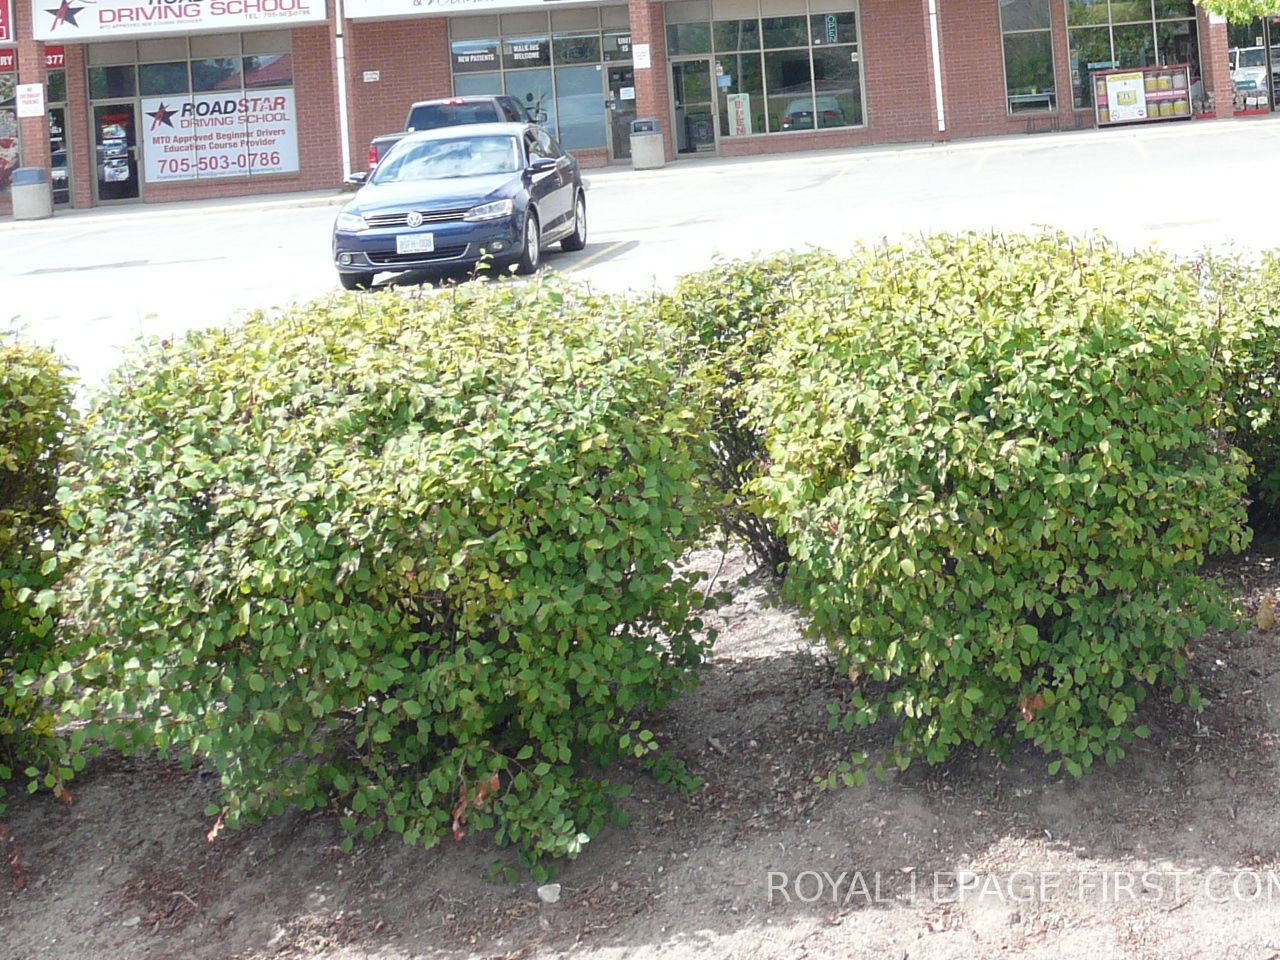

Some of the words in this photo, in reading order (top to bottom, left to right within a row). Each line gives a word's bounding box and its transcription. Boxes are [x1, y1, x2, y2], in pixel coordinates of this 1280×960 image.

[99, 3, 200, 23] DRIVING
[470, 53, 495, 62] PATIENTS
[513, 52, 540, 60] WELCOME
[181, 96, 286, 118] ROADSTAR
[180, 116, 234, 129] DRIVING
[238, 112, 291, 125] SCHOOL
[173, 133, 214, 144] Approved
[216, 129, 254, 141] Beginner
[256, 128, 286, 138] Drivers
[164, 142, 207, 153] Education
[209, 141, 238, 150] Course
[240, 138, 276, 148] Provider
[157, 151, 281, 174] 705-503-0786
